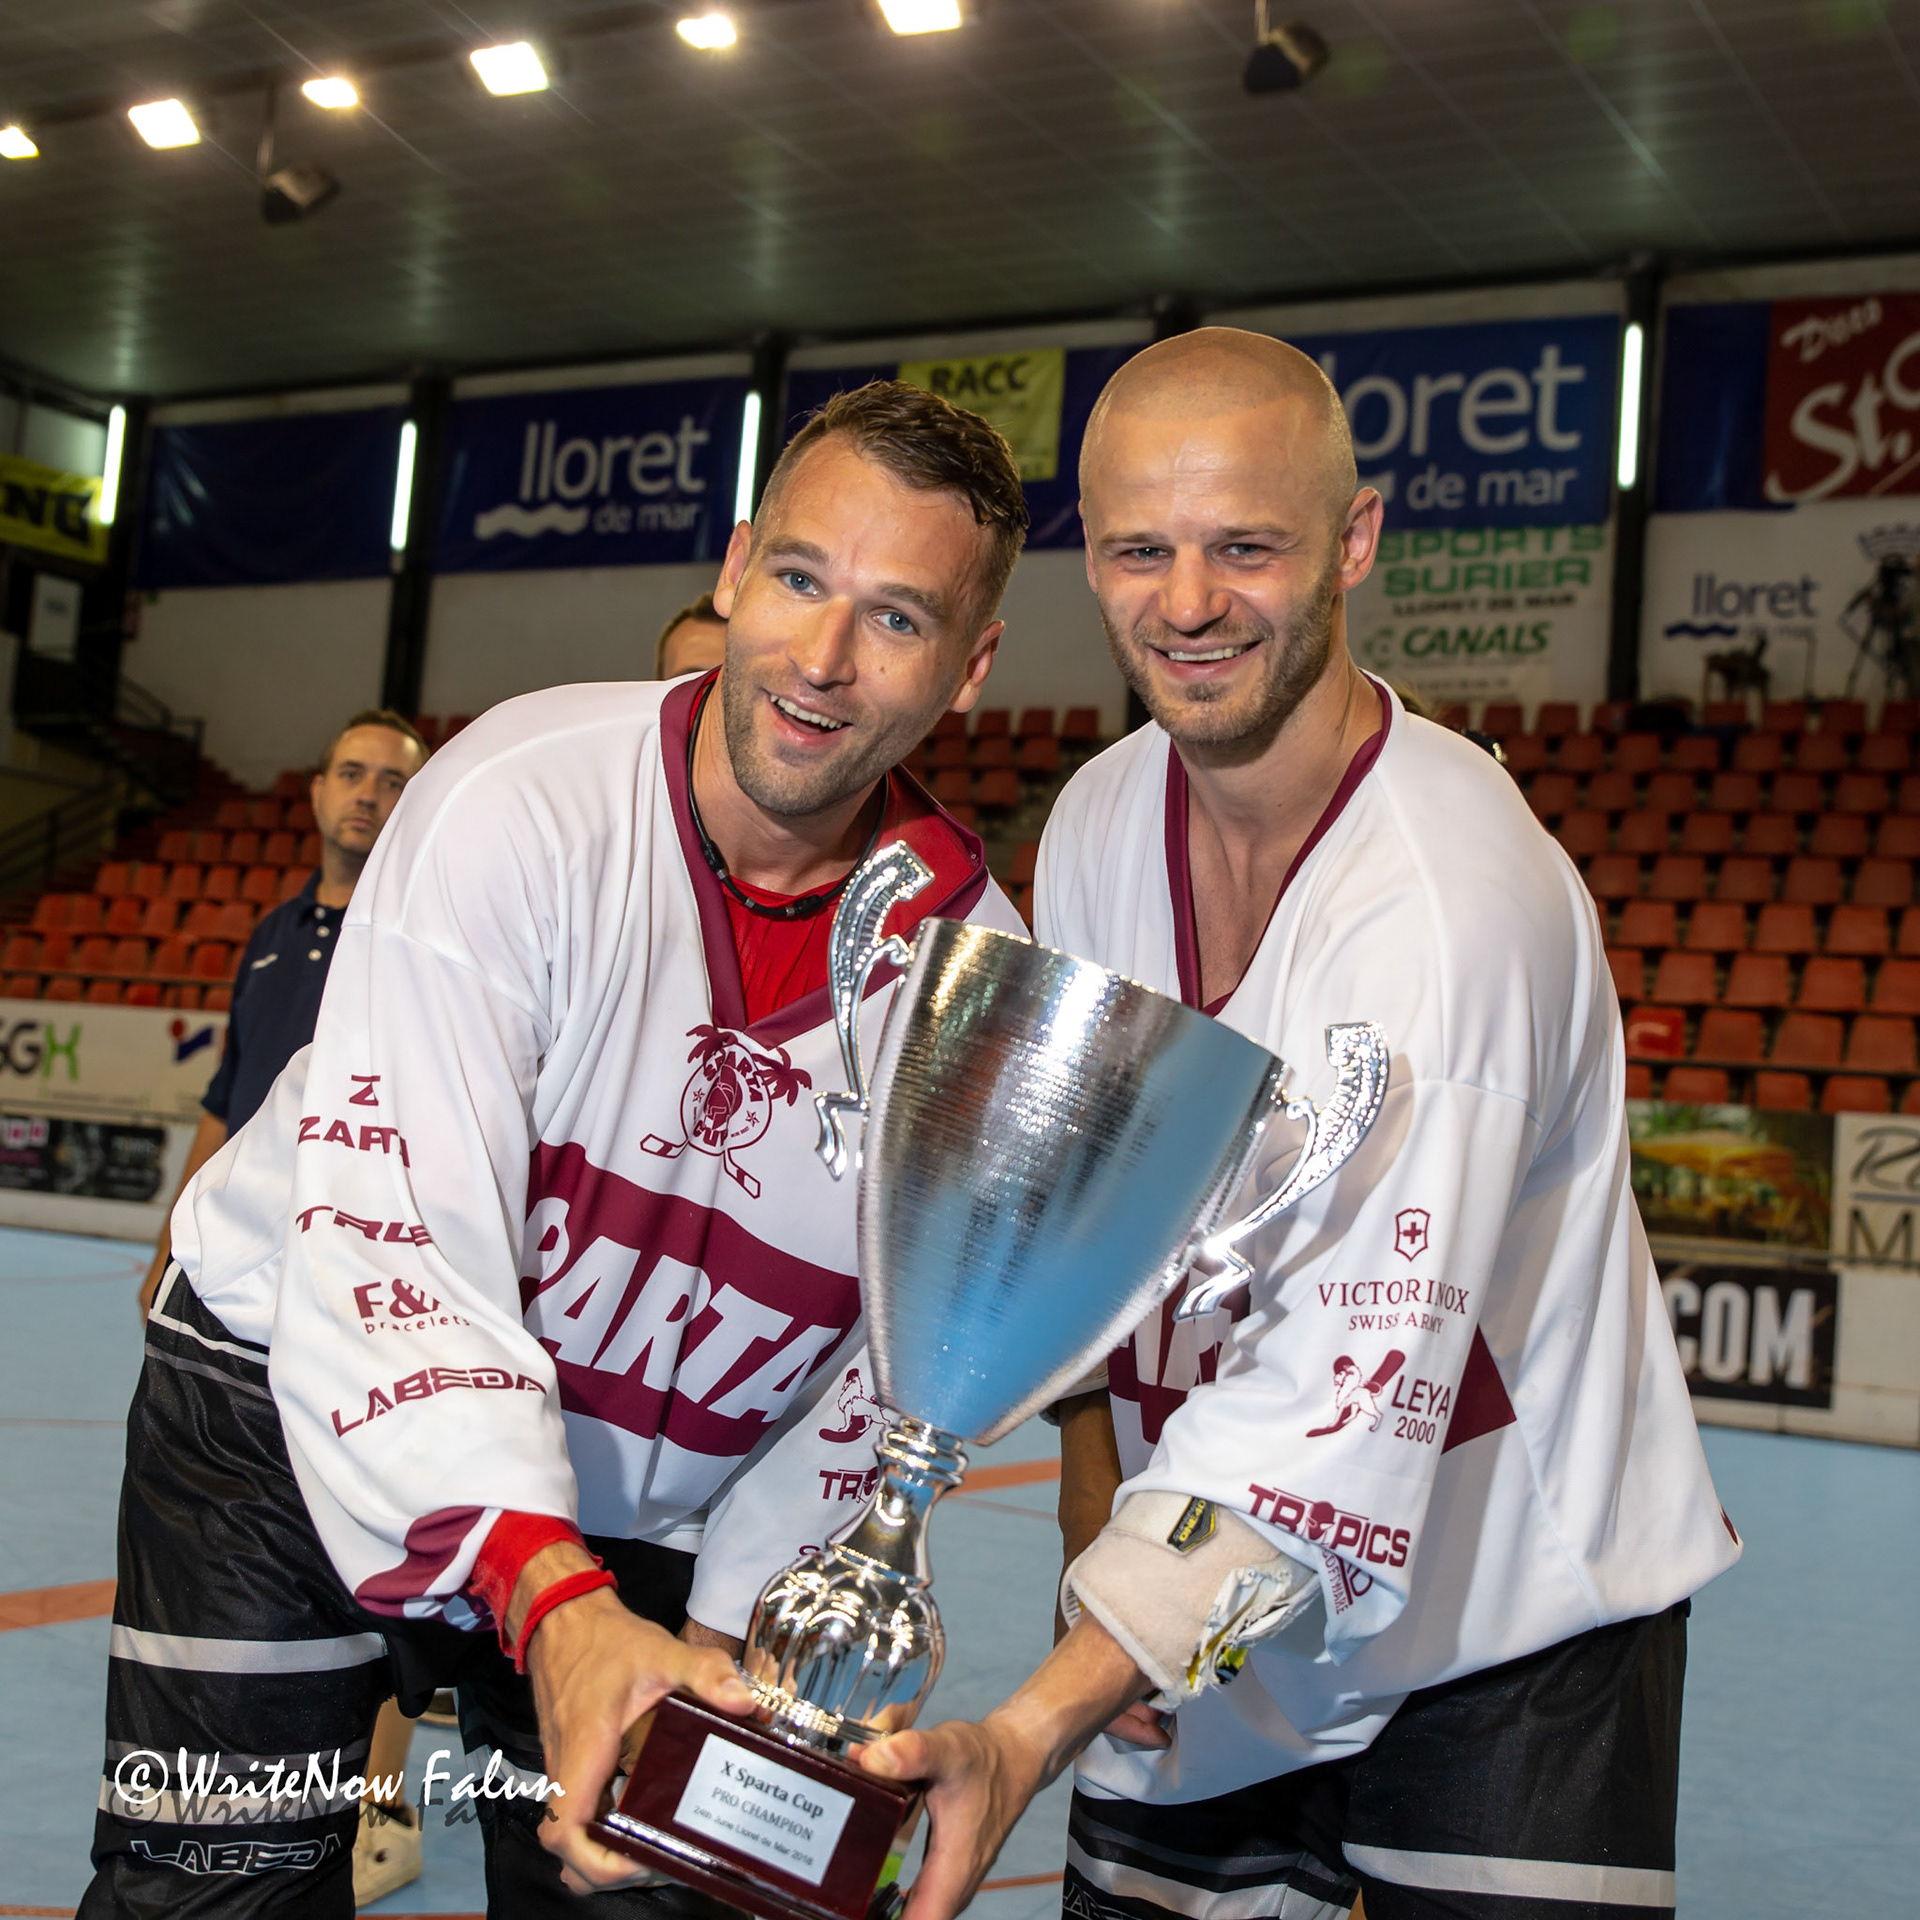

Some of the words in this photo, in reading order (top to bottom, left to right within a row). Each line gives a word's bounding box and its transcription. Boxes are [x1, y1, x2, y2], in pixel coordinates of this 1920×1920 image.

[931, 357, 1030, 397] RACC
[521, 416, 710, 501] lloret
[1406, 463, 1465, 510] de
[1478, 466, 1577, 508] mar
[594, 502, 631, 533] de
[637, 499, 700, 531] mar
[1378, 526, 1605, 562] SPORTS
[1692, 573, 1820, 618] lloret
[1403, 621, 1553, 658] CANALS
[0, 1017, 83, 1083] GH
[519, 1197, 842, 1421] PARTA
[1318, 1278, 1471, 1315] VICTORINOX
[1348, 1314, 1399, 1332] SWISS
[1403, 1313, 1446, 1335] ARMY
[331, 1366, 547, 1439] LABEDA
[1391, 1373, 1452, 1420] LEYA
[1394, 1416, 1437, 1445] 2000
[720, 1760, 735, 1777] X
[735, 1767, 789, 1801] Sparta
[792, 1793, 824, 1819] Cup
[711, 1786, 739, 1807] PRO
[741, 1800, 814, 1841] CHAMPION
